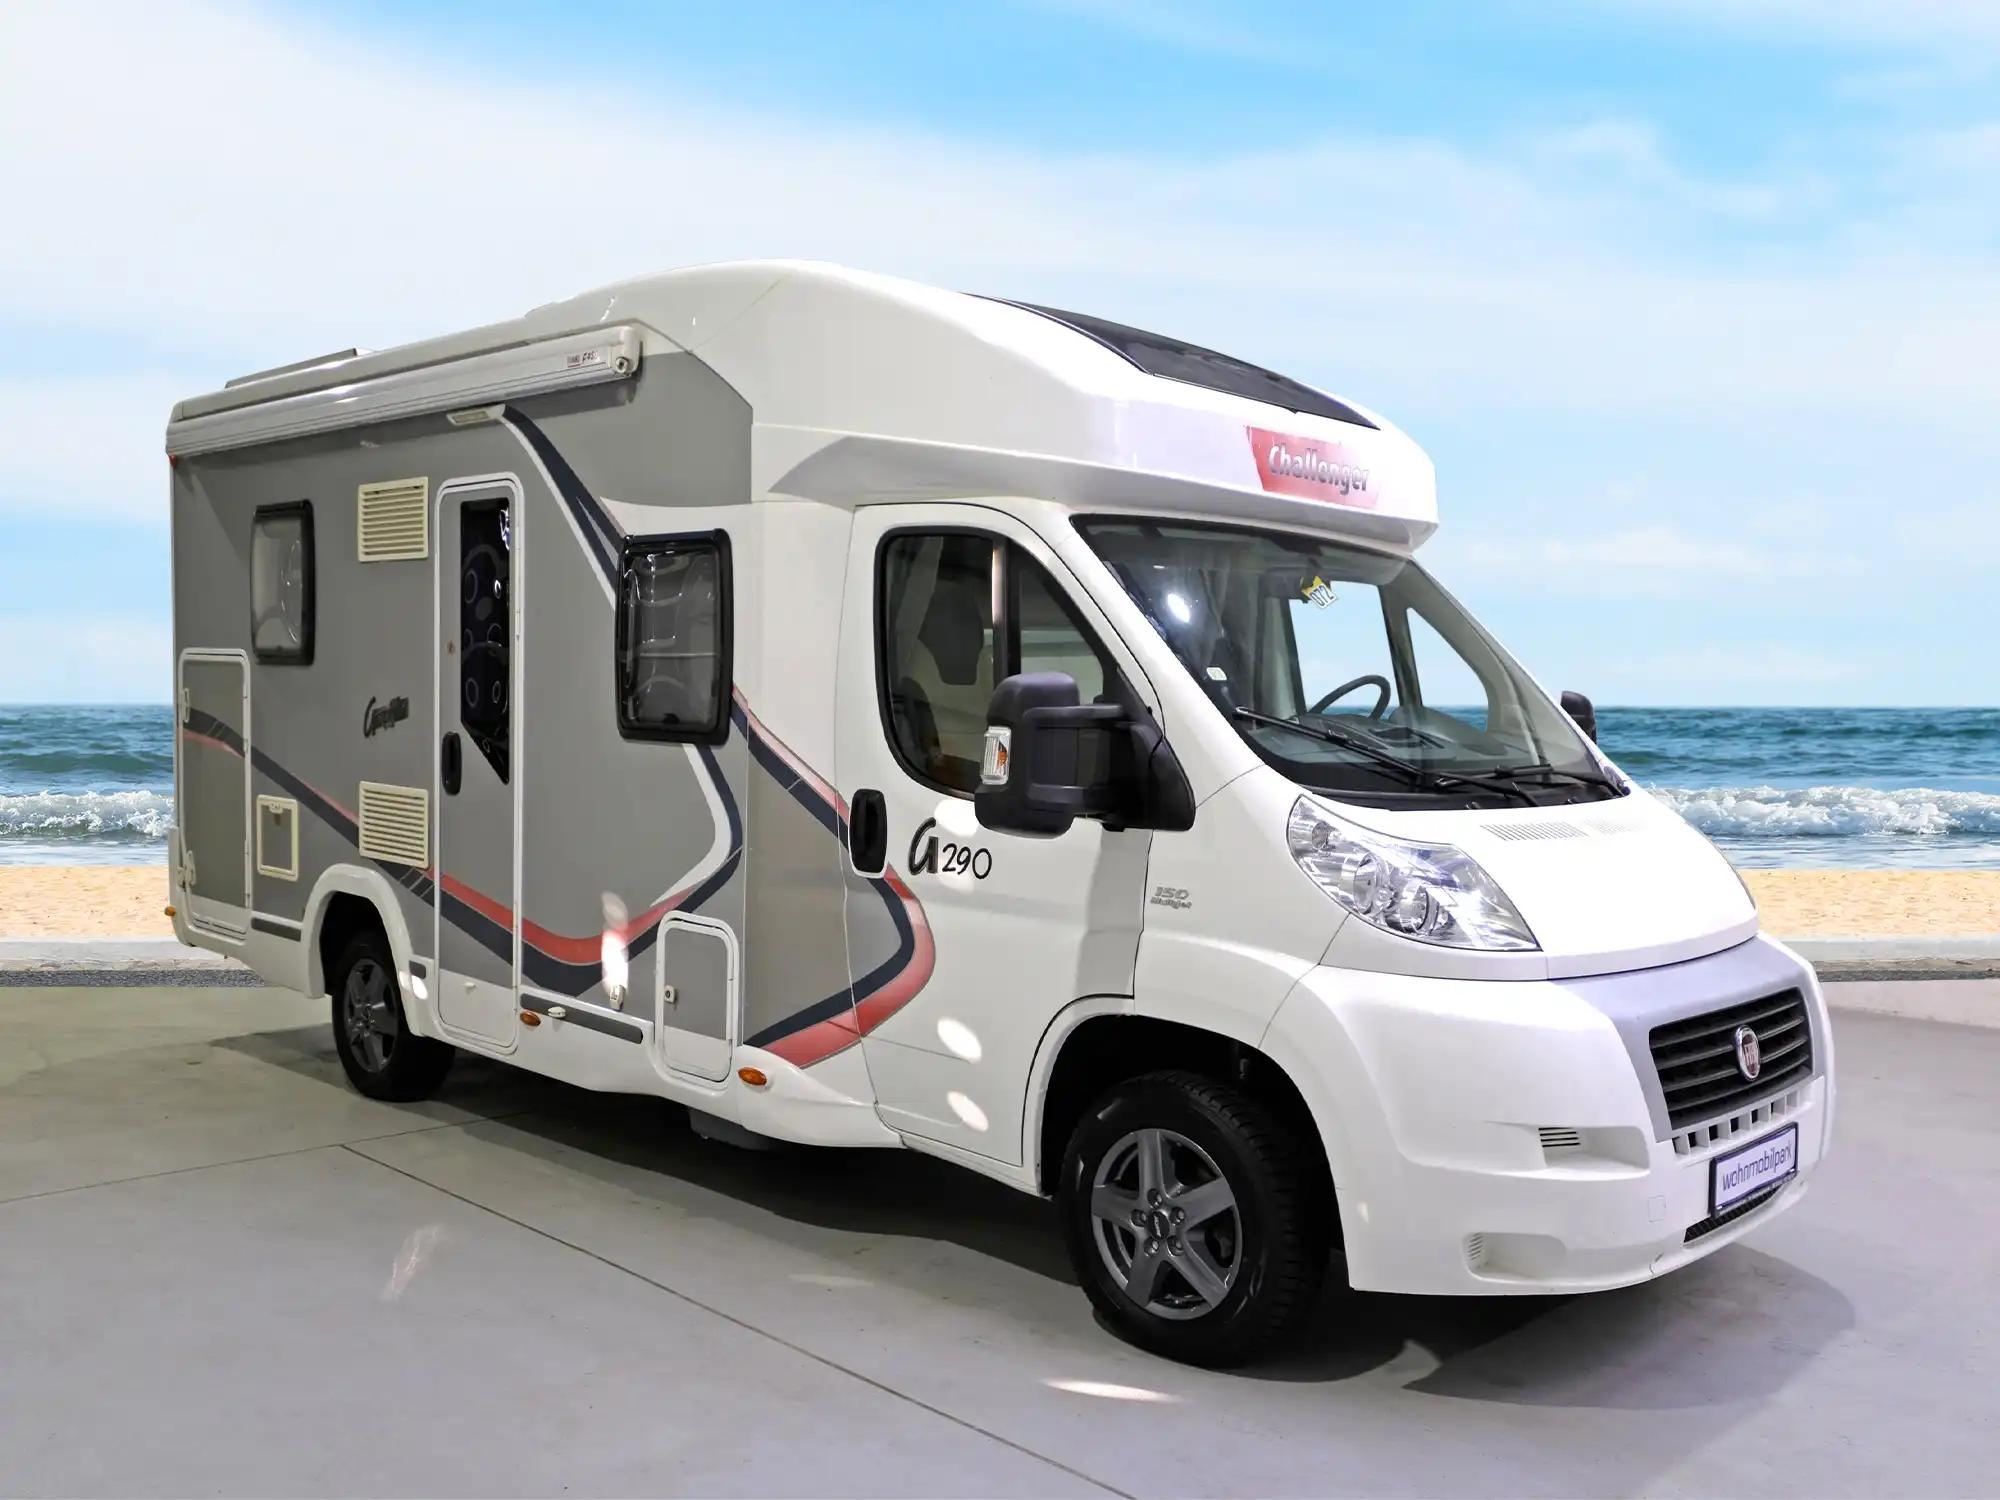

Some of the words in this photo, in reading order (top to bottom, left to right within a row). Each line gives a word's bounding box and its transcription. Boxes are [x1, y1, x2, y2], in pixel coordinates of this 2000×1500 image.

[1269, 443, 1370, 495] Challenger
[1310, 585, 1335, 606] 072
[1154, 886, 1190, 900] 150
[1722, 1140, 1792, 1191] wohnmobilpark
